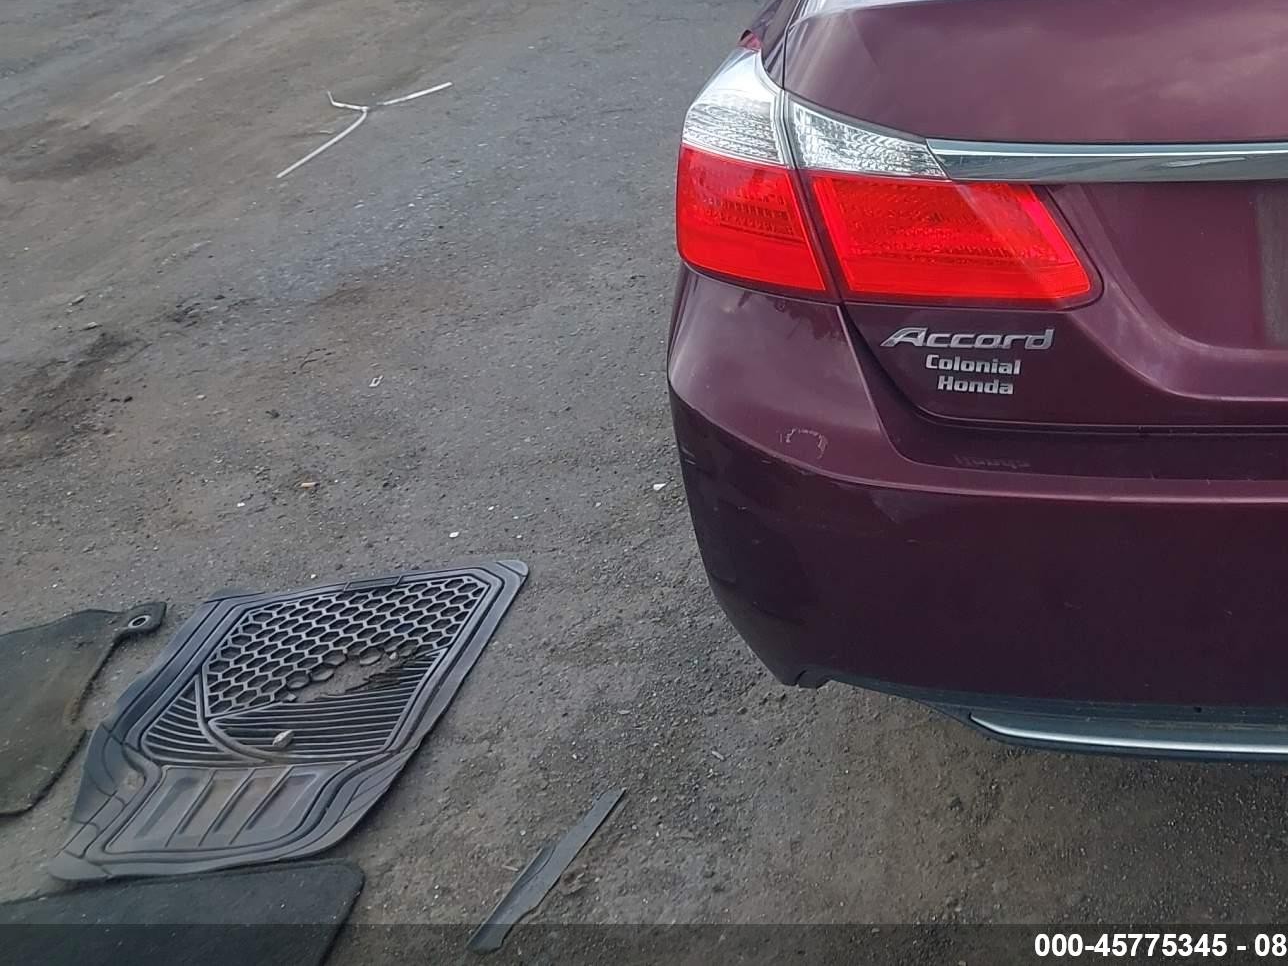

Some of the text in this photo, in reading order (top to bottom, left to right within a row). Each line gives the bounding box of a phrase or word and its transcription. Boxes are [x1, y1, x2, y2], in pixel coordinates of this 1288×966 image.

[880, 327, 1055, 350] Accord
[925, 354, 1021, 375] Colonial
[937, 375, 1014, 395] Honda
